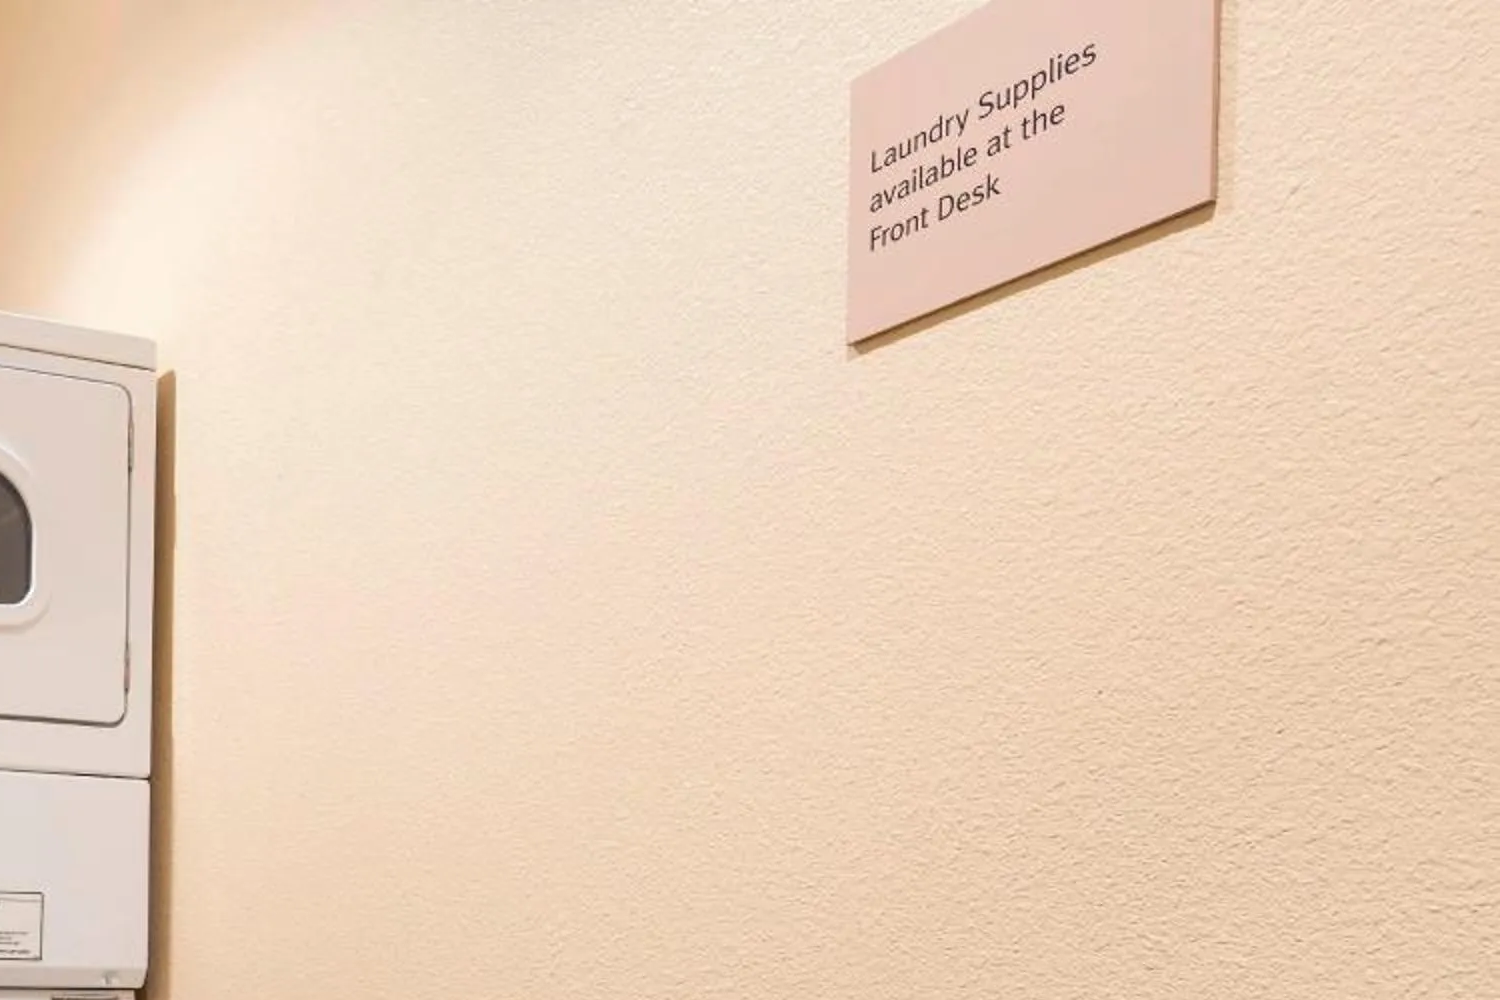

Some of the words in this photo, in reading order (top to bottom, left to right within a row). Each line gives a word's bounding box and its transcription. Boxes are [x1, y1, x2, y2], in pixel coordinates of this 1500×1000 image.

[869, 146, 977, 213] available
[986, 125, 1011, 158] at
[1021, 103, 1066, 141] the
[870, 108, 969, 174] Laundry
[978, 42, 1098, 121] Supplies
[868, 207, 929, 252] Front
[937, 174, 1001, 223] Desk
